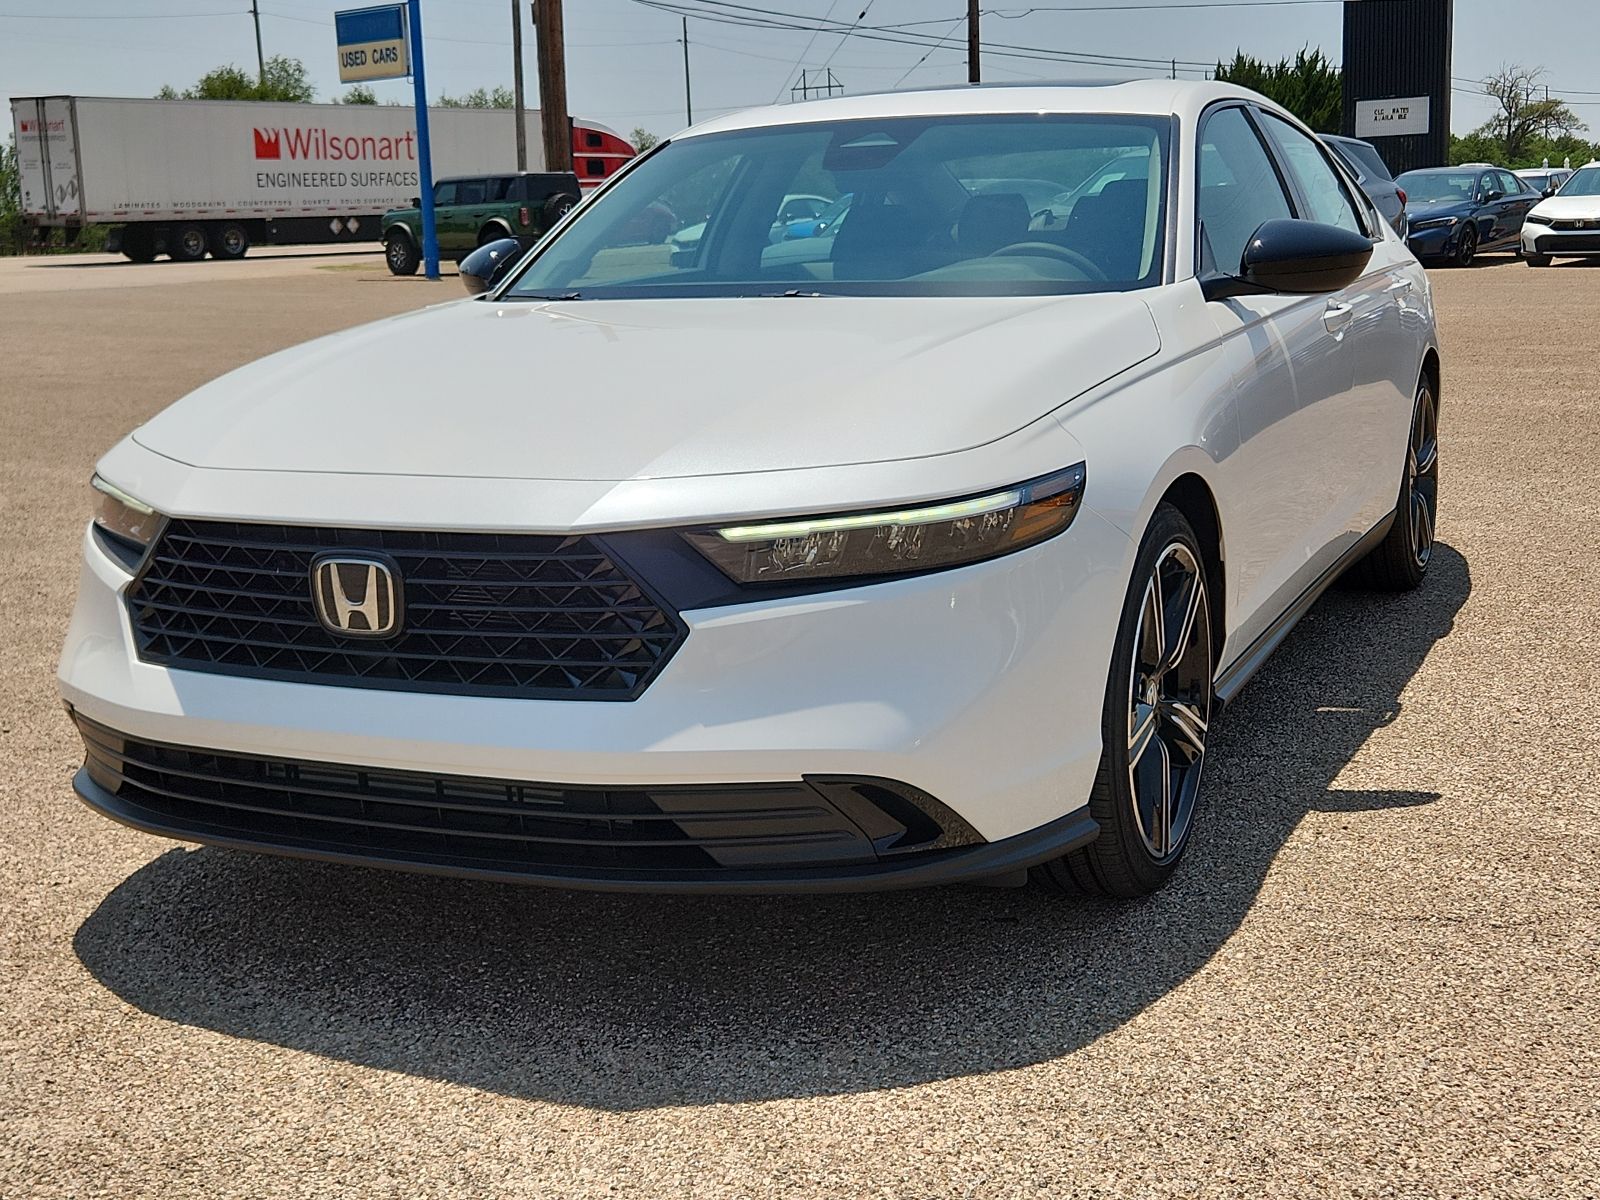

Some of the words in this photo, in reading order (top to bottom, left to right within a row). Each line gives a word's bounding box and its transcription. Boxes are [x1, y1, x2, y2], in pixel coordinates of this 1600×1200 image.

[341, 50, 367, 68] USED
[372, 46, 398, 64] CARS
[284, 128, 414, 160] Wilsonart
[256, 173, 347, 188] ENGINEERED
[350, 172, 418, 187] SURFACES
